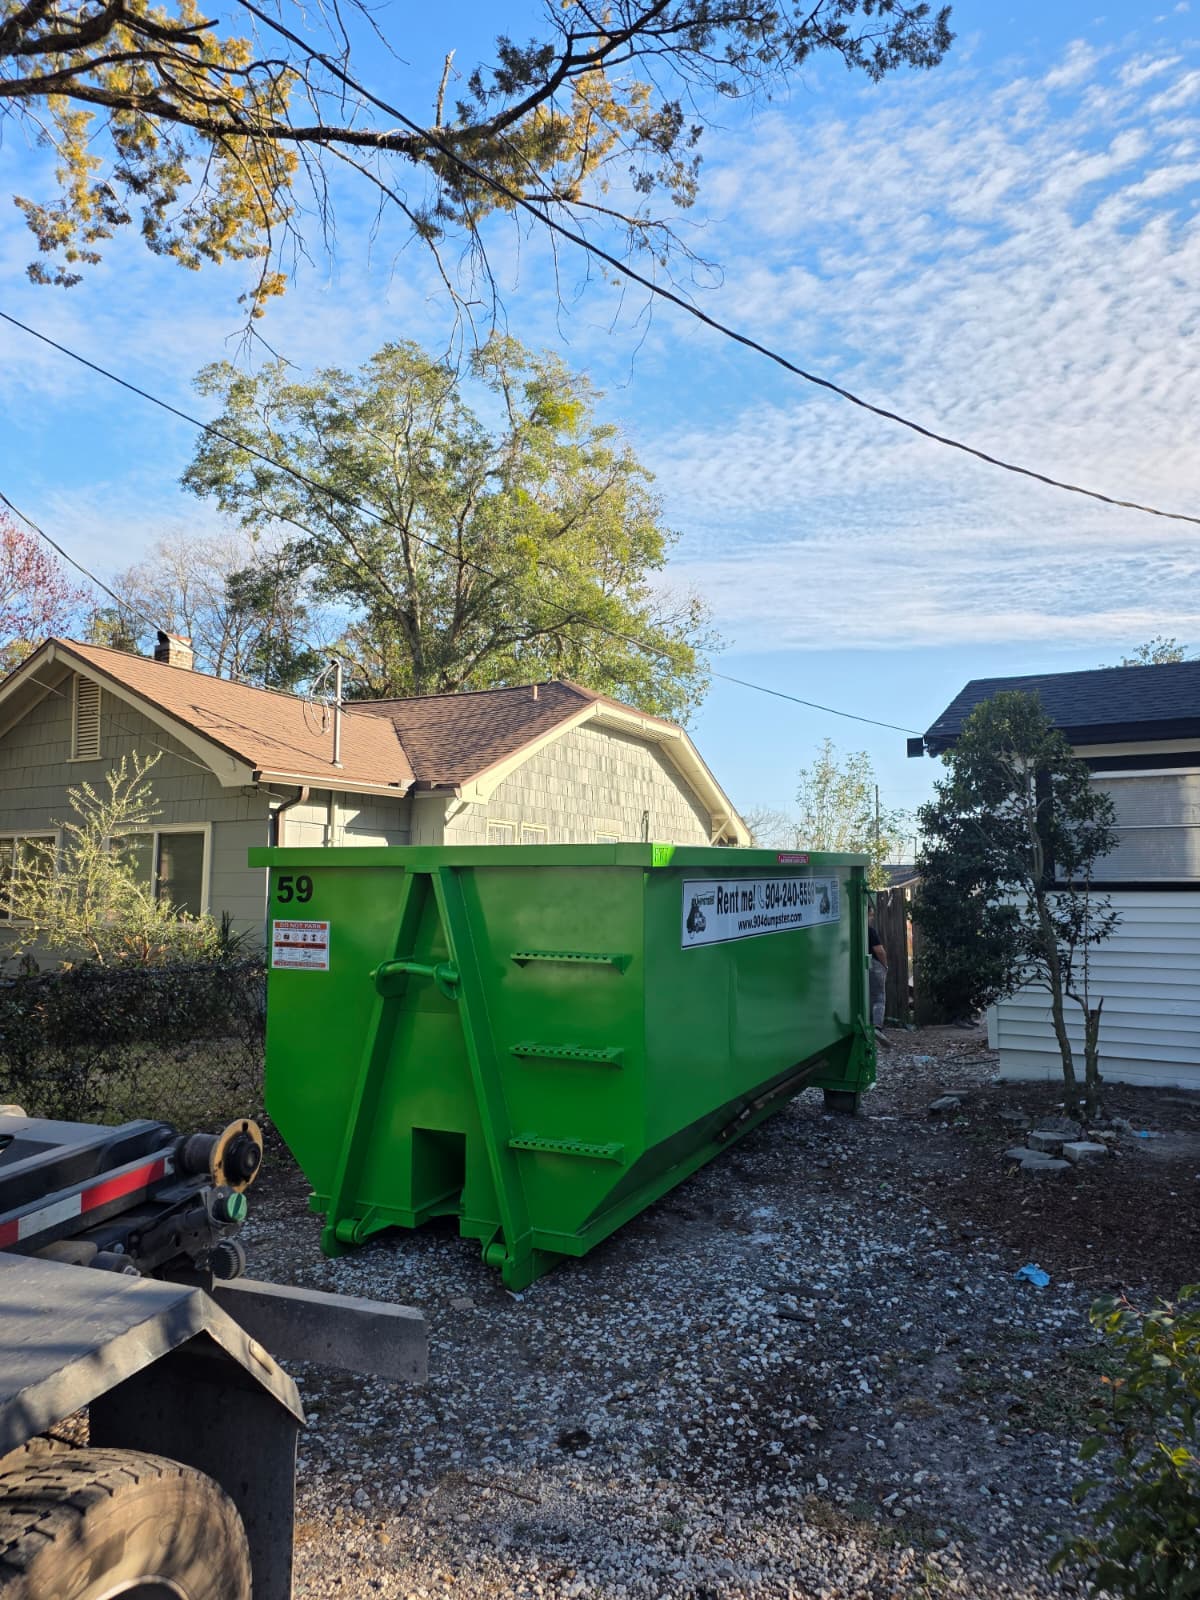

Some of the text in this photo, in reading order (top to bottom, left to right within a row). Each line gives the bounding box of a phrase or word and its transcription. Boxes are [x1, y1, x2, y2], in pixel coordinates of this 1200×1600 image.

[277, 875, 313, 903] 59
[716, 885, 739, 915] Rent
[741, 885, 756, 911] me!
[738, 912, 802, 931] www.904dumpster.com
